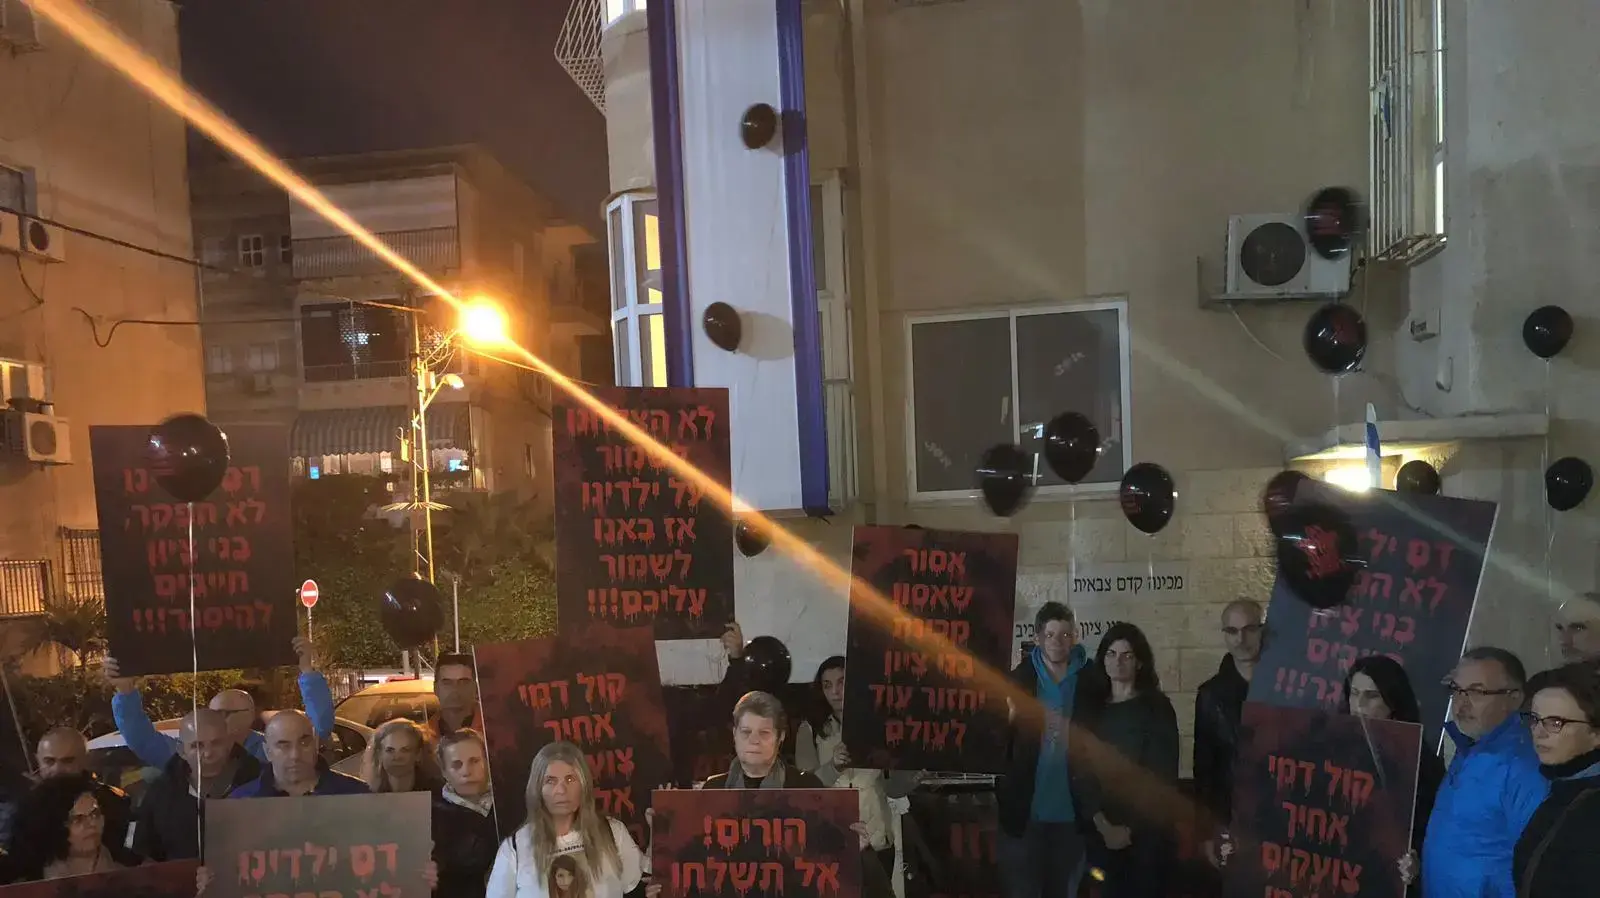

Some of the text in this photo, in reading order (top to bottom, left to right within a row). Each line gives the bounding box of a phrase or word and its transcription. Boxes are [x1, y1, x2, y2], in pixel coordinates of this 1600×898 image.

[678, 405, 716, 441] לא
[582, 477, 660, 511] ילדינו
[225, 498, 266, 525] לא
[594, 516, 696, 547] אז באנו
[147, 536, 252, 567] בני ציון
[600, 549, 692, 583] לשמור
[903, 547, 967, 579] אסור
[1405, 538, 1455, 574] דם
[587, 584, 708, 620] עליכם!!!
[892, 581, 976, 613] שאסון
[1073, 575, 1184, 595] מכינה קדם צבאית
[1399, 576, 1448, 614] לא
[1080, 620, 1102, 640] ציון
[1373, 611, 1416, 645] בני
[883, 649, 928, 682] ציון
[518, 672, 627, 709] קול דמי
[868, 684, 987, 714] יחזור עוד
[543, 712, 616, 744] אחיך
[885, 716, 967, 751] לעולם
[1268, 754, 1375, 810] קול דמי
[703, 814, 807, 856] הורים!
[1282, 801, 1350, 850] אחיך
[238, 841, 399, 887] דם ילדינו
[671, 856, 840, 898] אל תשלחו
[1261, 841, 1362, 894] צועקים
